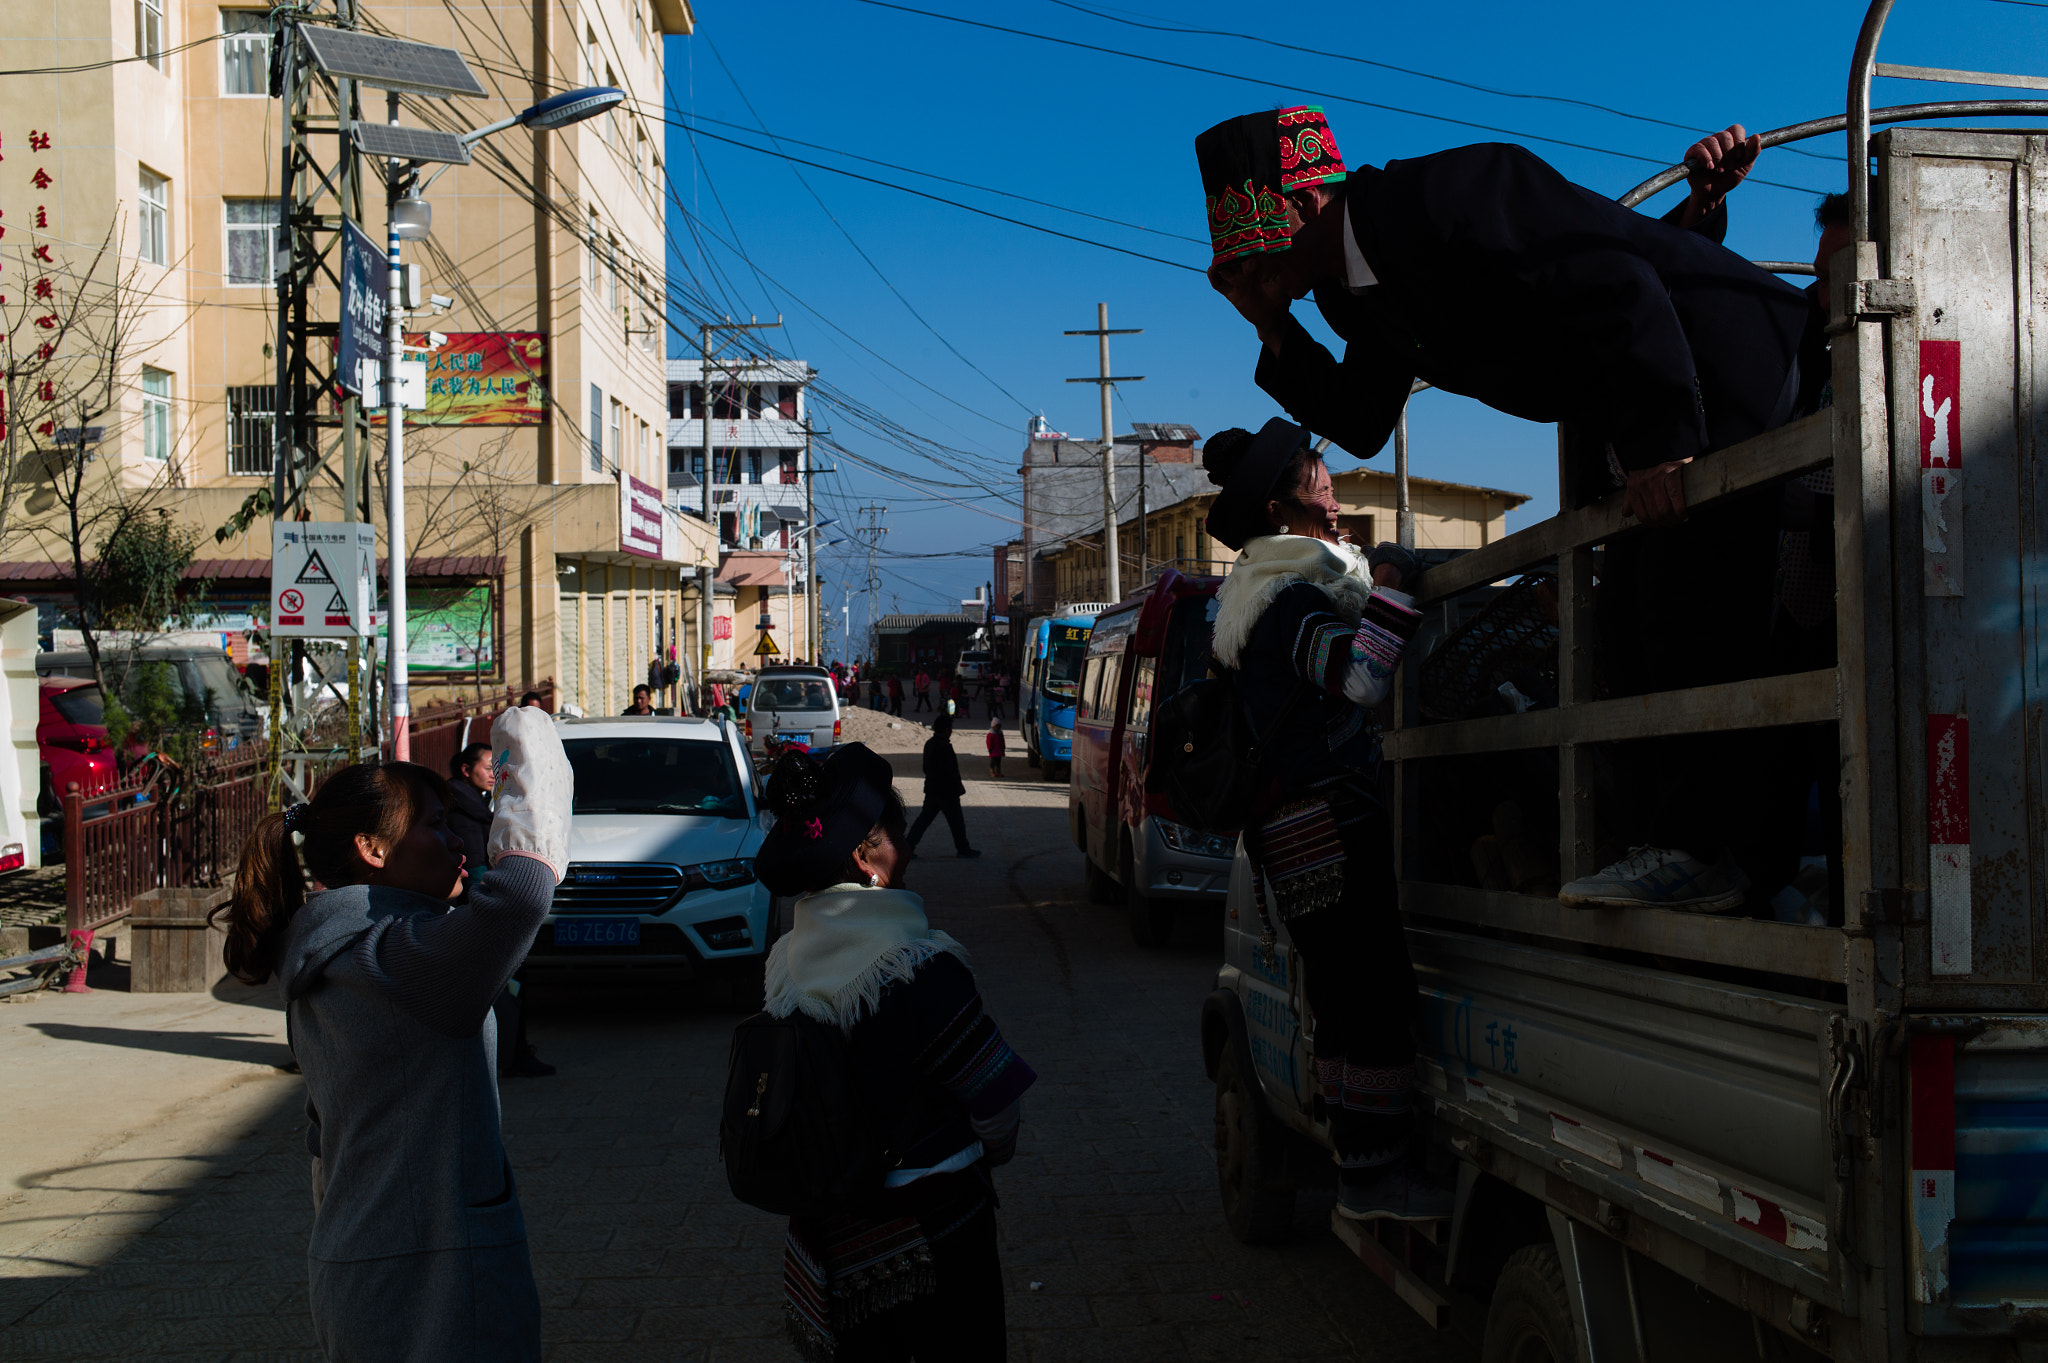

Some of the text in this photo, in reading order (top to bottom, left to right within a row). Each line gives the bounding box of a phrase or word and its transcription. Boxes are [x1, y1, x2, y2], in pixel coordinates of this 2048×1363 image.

[1936, 475, 1945, 494] 3M
[1484, 1020, 1519, 1075] 千克
[1926, 1178, 1936, 1198] 3M
